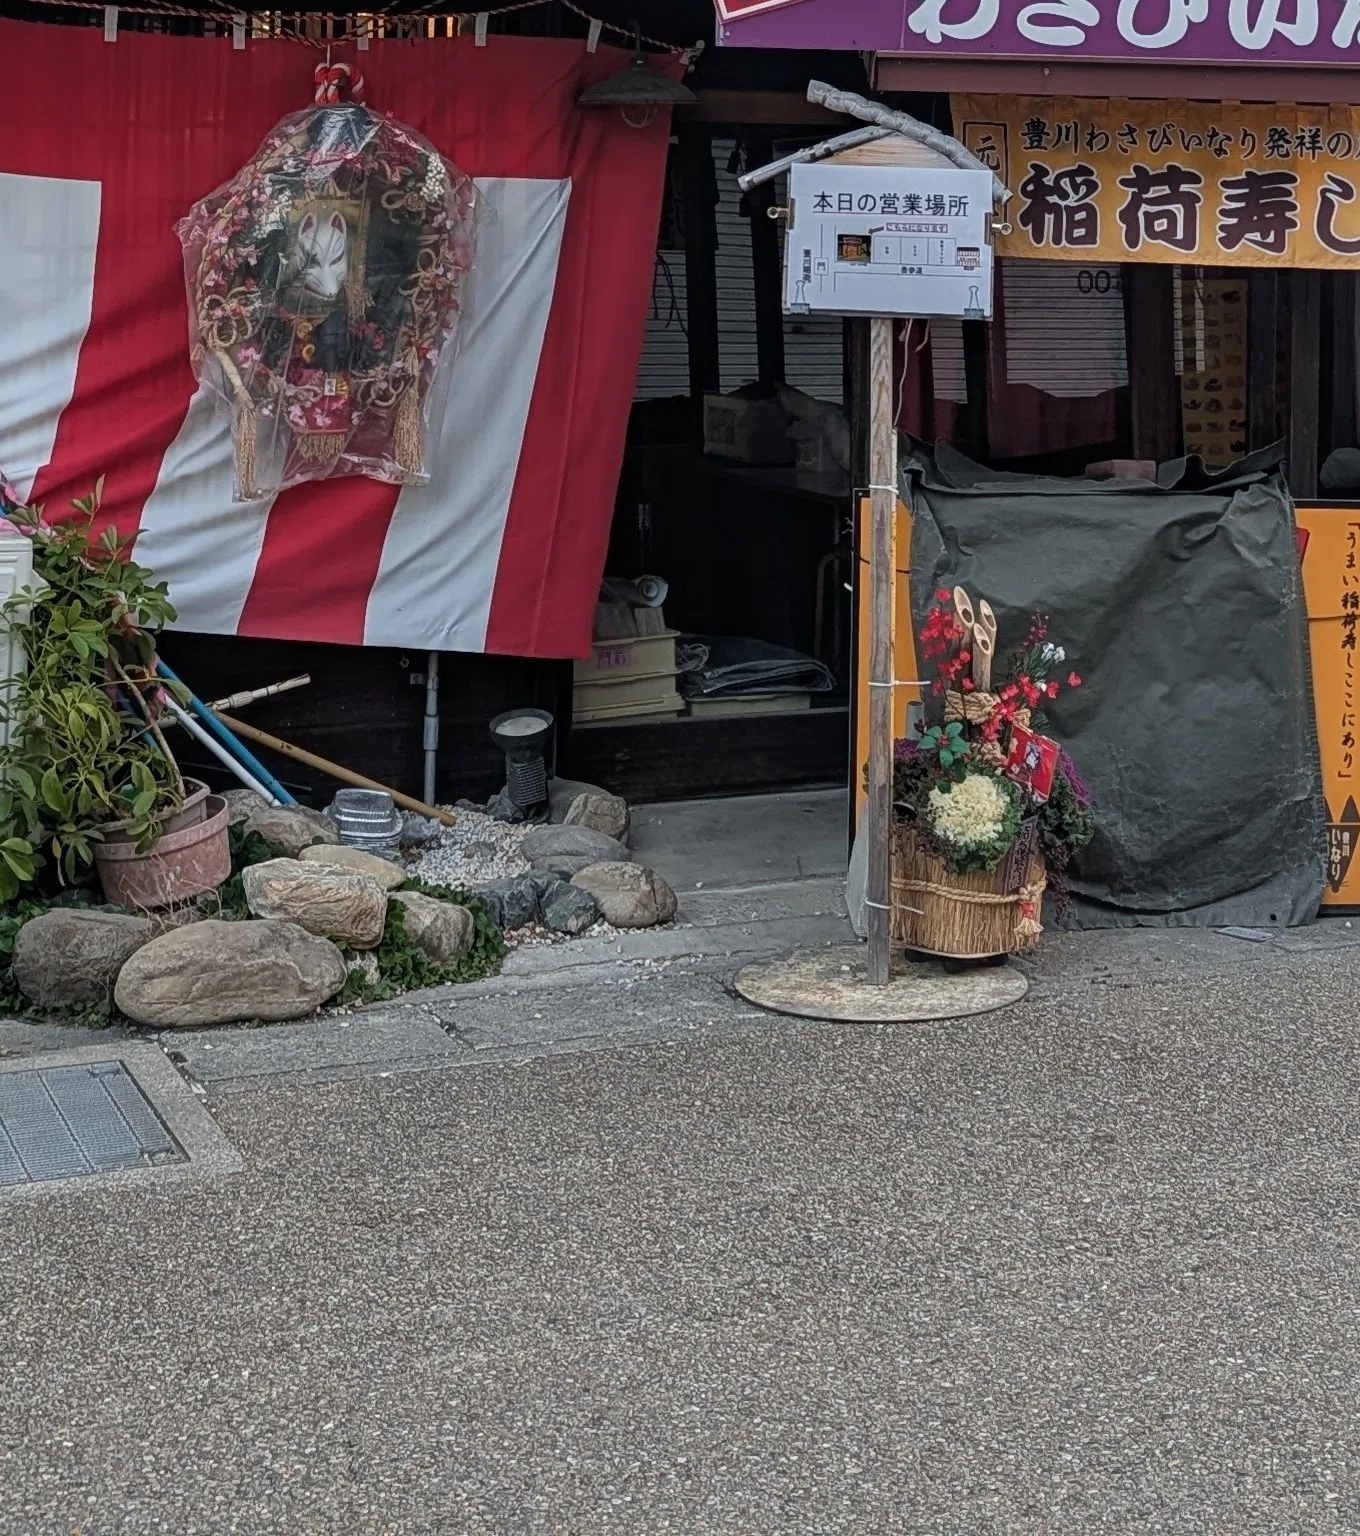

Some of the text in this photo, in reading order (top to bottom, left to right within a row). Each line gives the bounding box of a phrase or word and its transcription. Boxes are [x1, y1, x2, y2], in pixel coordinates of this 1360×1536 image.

[812, 191, 970, 216] 本日の営業場所
[1330, 828, 1342, 881] いなり
